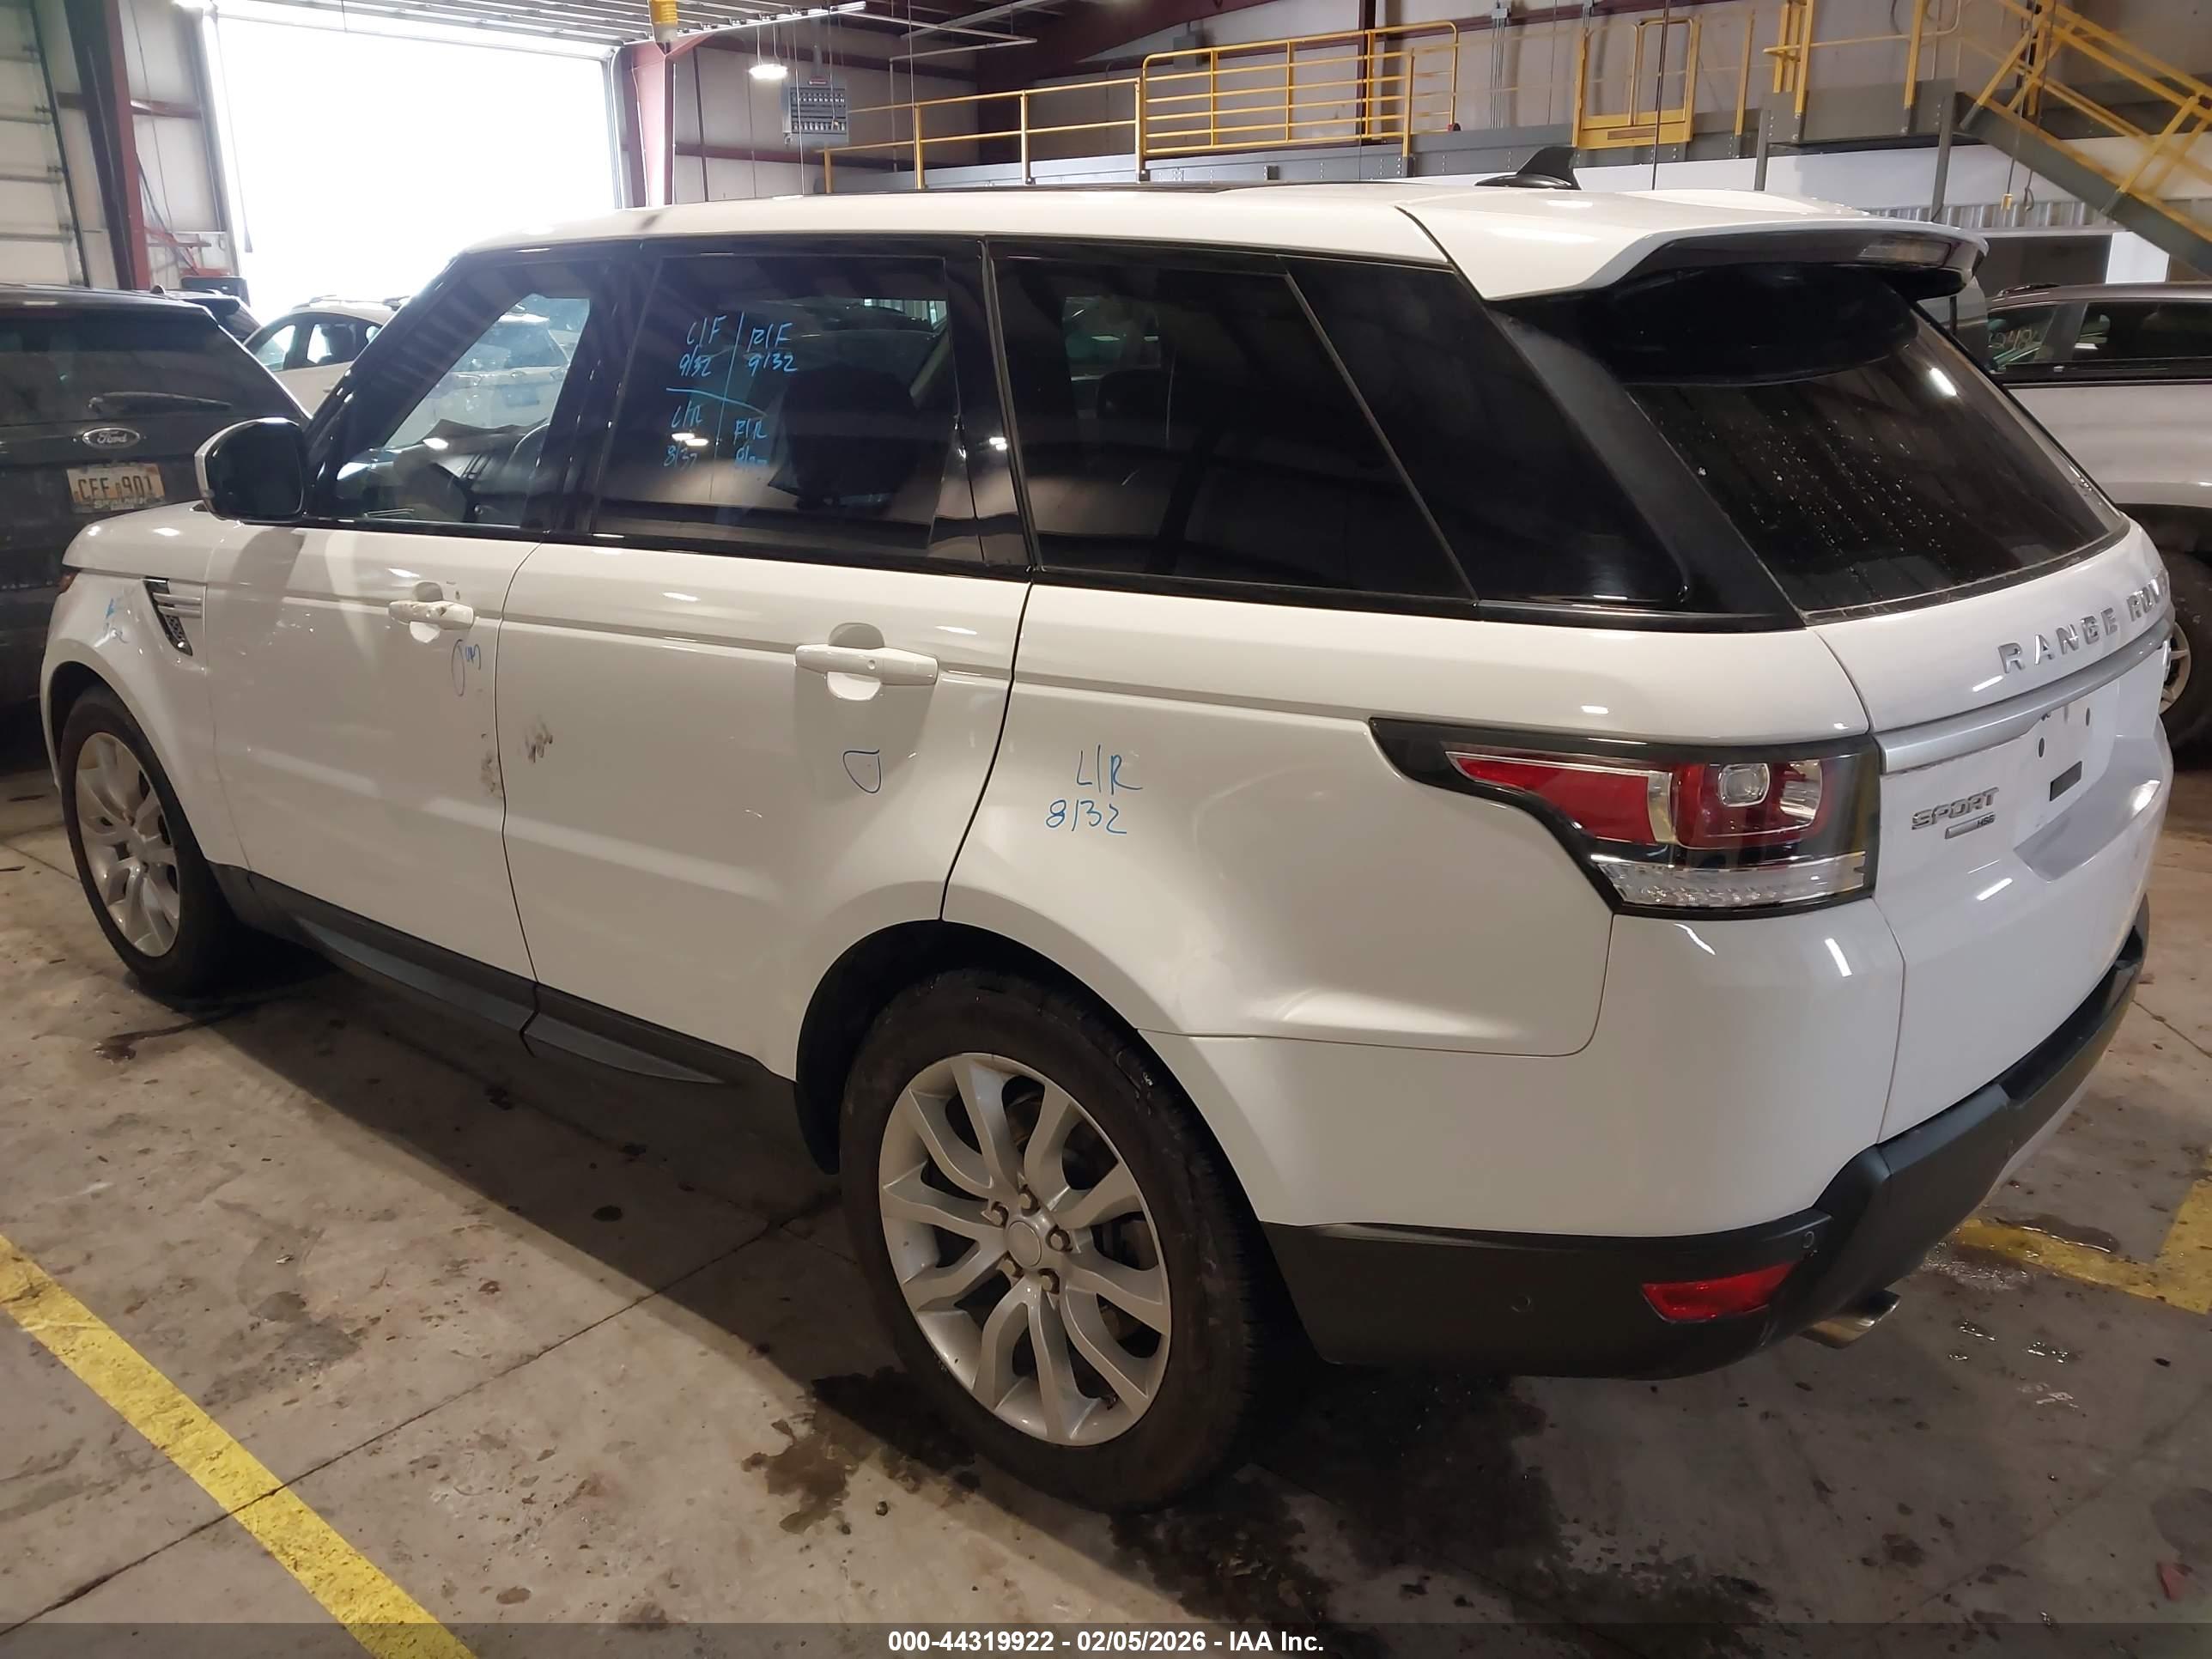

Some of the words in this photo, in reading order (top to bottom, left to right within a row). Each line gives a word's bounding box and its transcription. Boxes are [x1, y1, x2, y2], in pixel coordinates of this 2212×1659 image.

[96, 431, 128, 444] Ford
[1997, 607, 2119, 674] RANGE
[1911, 787, 2000, 830] SPORT
